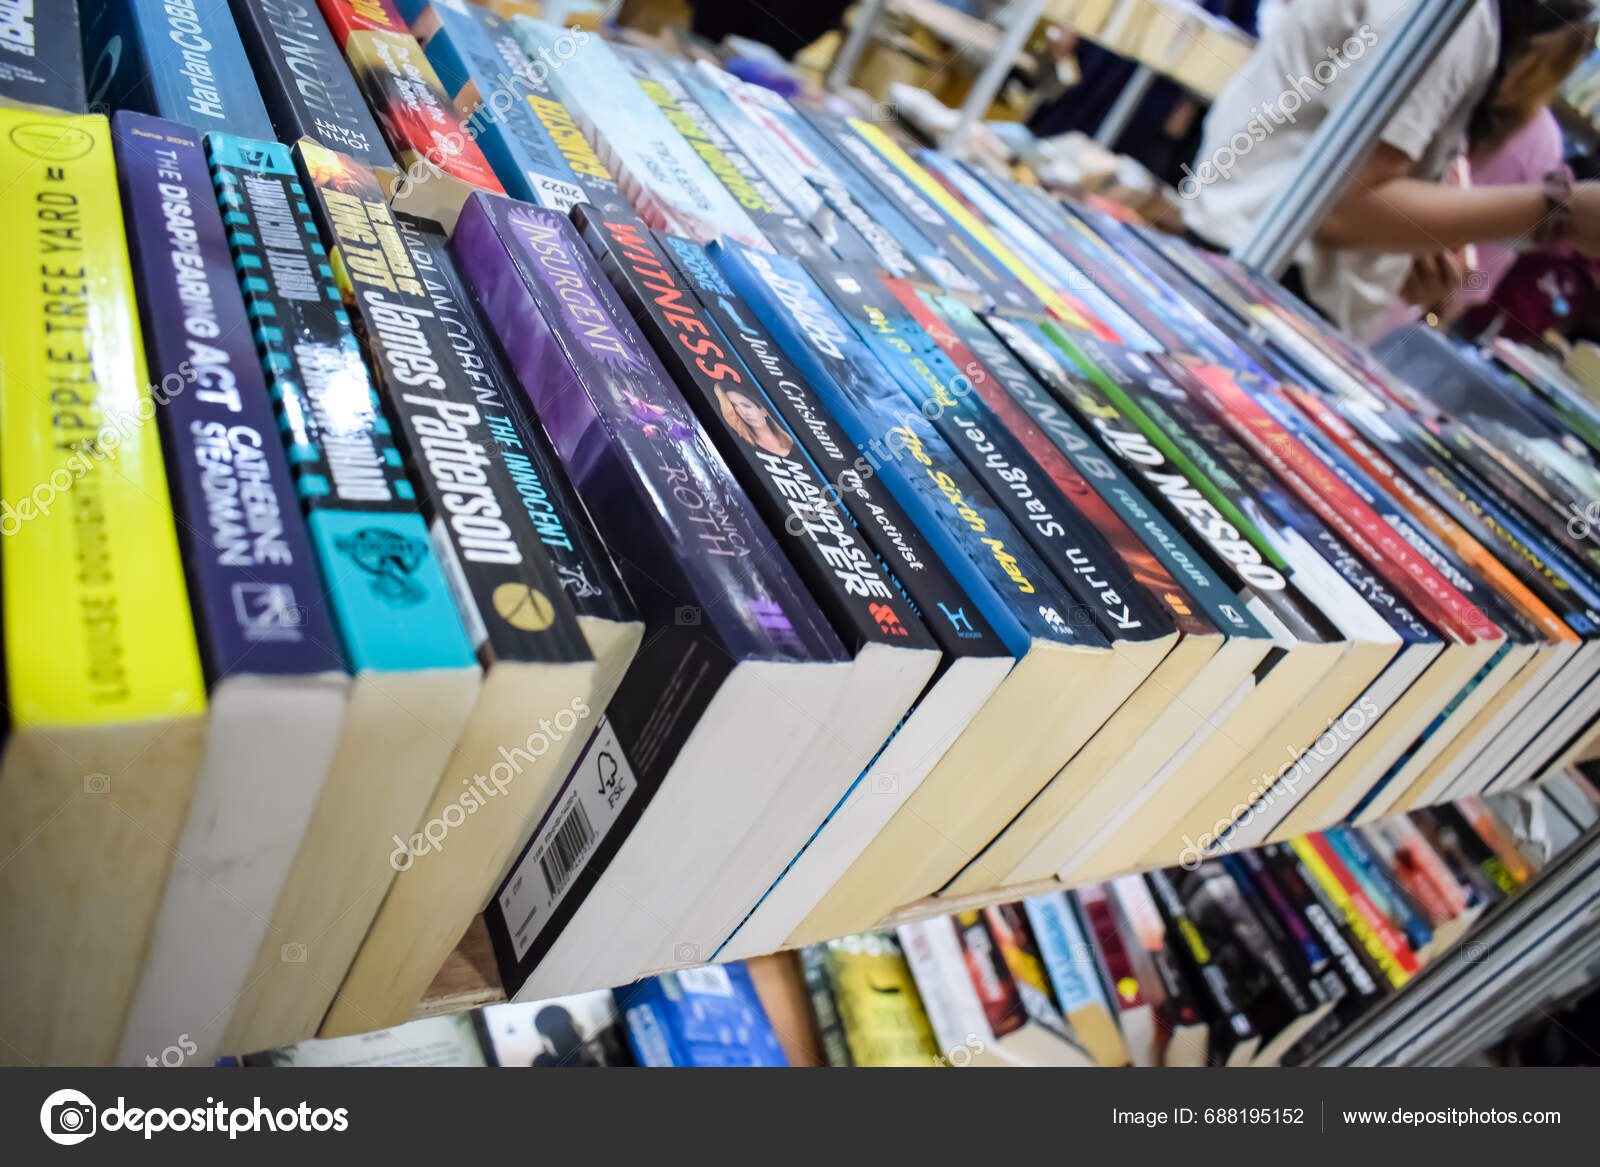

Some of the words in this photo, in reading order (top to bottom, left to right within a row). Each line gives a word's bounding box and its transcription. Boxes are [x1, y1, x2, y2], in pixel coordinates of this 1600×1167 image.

[154, 149, 183, 183] THE
[314, 117, 367, 142] HART
[316, 126, 371, 152] JOHN
[37, 191, 83, 257] YARD
[158, 181, 221, 338] DISAPPEARING
[320, 187, 378, 246] KING
[342, 242, 400, 293] TUT
[42, 264, 91, 337] TREE
[362, 290, 447, 393] James
[512, 218, 633, 362] INSURGENT
[603, 221, 742, 384] WITNESS
[188, 339, 243, 413] ACT
[740, 329, 784, 378] John
[778, 378, 844, 461] Grisham
[402, 393, 523, 565] Patterson
[485, 415, 524, 449] THE
[953, 415, 1066, 538] Slaughter
[190, 419, 254, 567] STEADMAN
[226, 424, 293, 566] CATHERINE
[501, 450, 574, 553] INNOCENT
[659, 462, 735, 557] ROTH
[756, 450, 870, 597] HELLER
[780, 456, 893, 600] MANDASUE
[842, 468, 871, 500] The
[866, 501, 928, 572] Activist
[891, 426, 932, 466] The
[927, 468, 986, 533] Sixth
[981, 536, 1035, 594] Man
[1112, 487, 1148, 518] FOR
[1144, 521, 1211, 588] VALOUR
[1064, 546, 1143, 631] Karin
[607, 777, 627, 810] FSC
